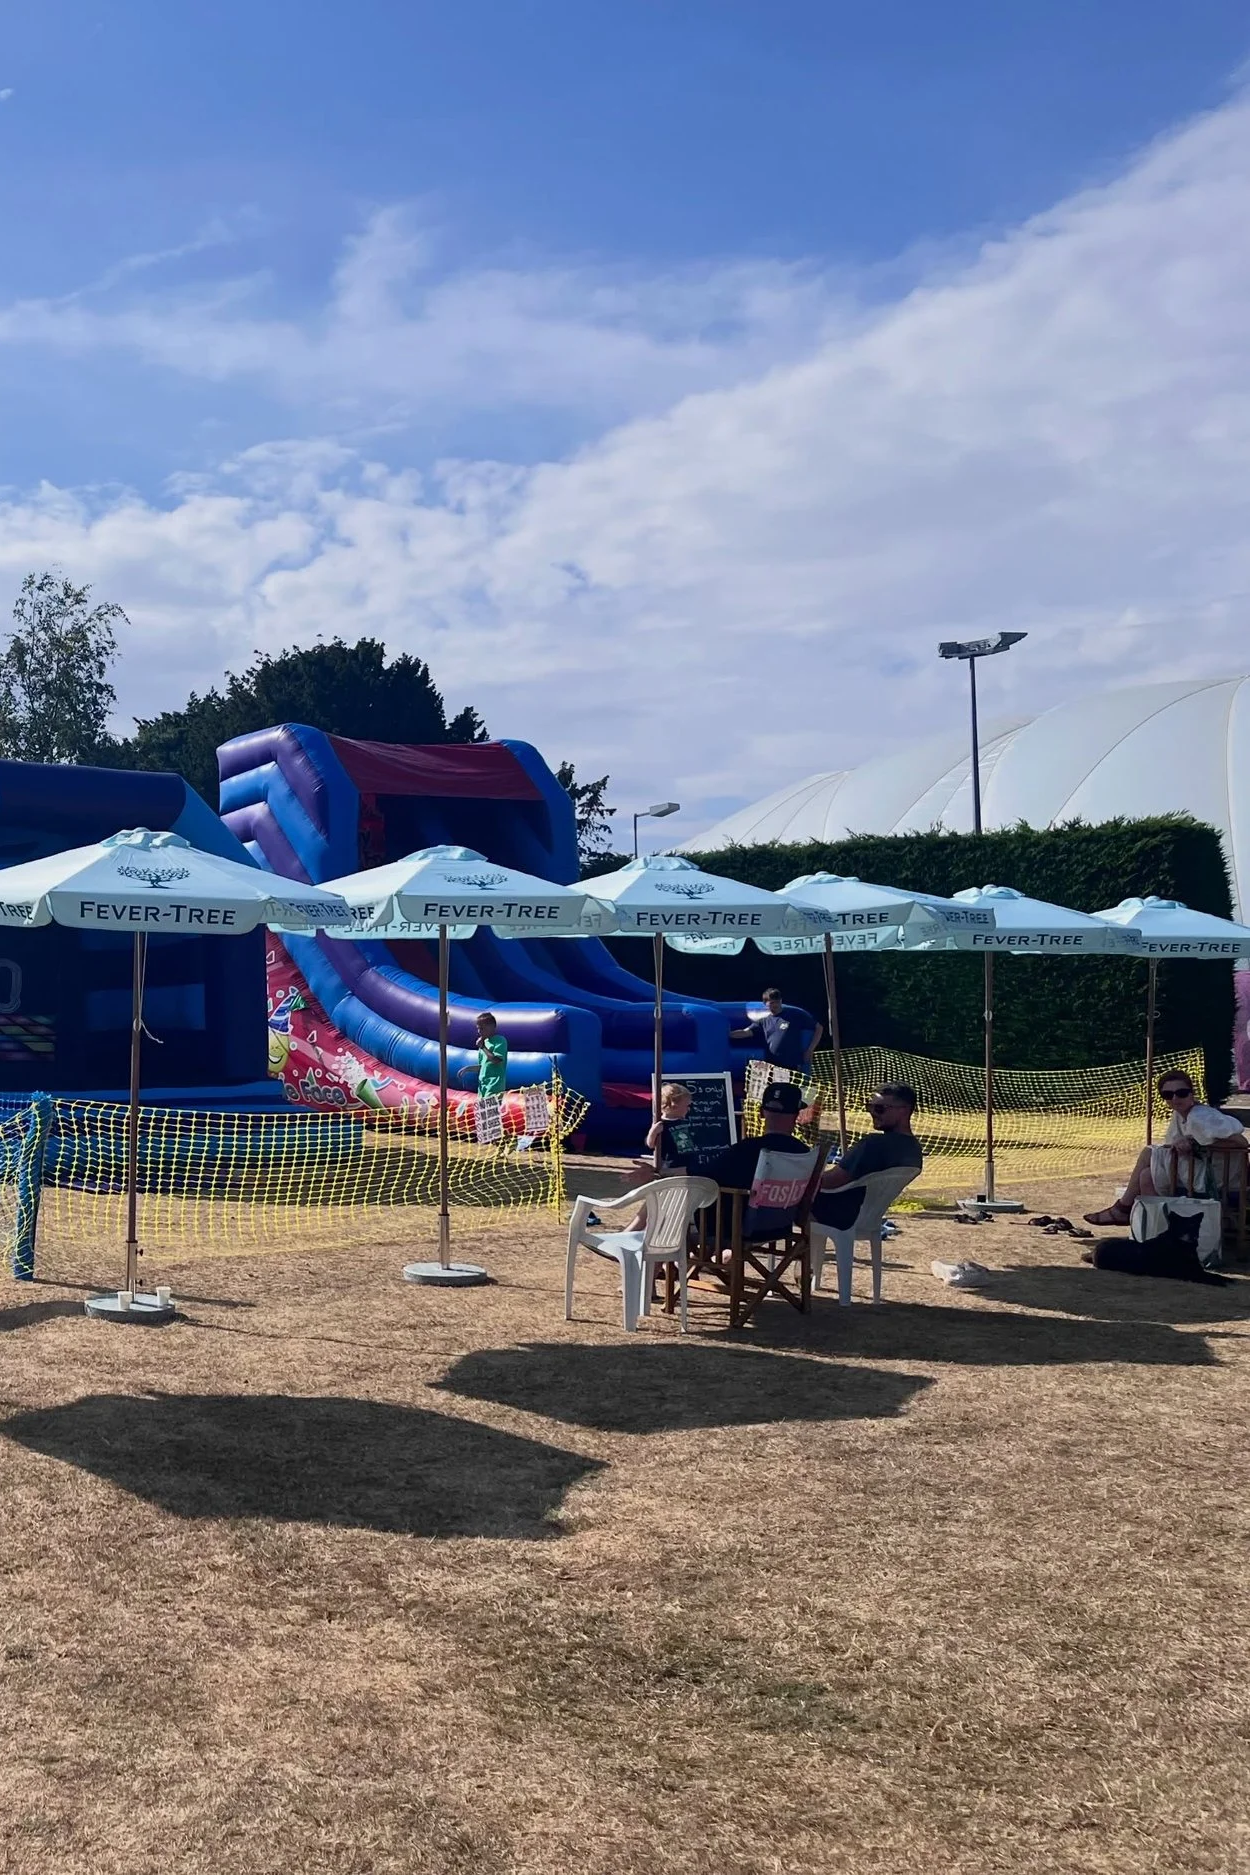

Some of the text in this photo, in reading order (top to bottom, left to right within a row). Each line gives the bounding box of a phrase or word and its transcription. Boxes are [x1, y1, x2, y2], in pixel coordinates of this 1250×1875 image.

[80, 901, 236, 926] FEVER-TREE
[423, 903, 561, 920] FEVER-TREE
[636, 911, 763, 927] FEVER-TREE
[972, 933, 1084, 947] FEVER-TREE
